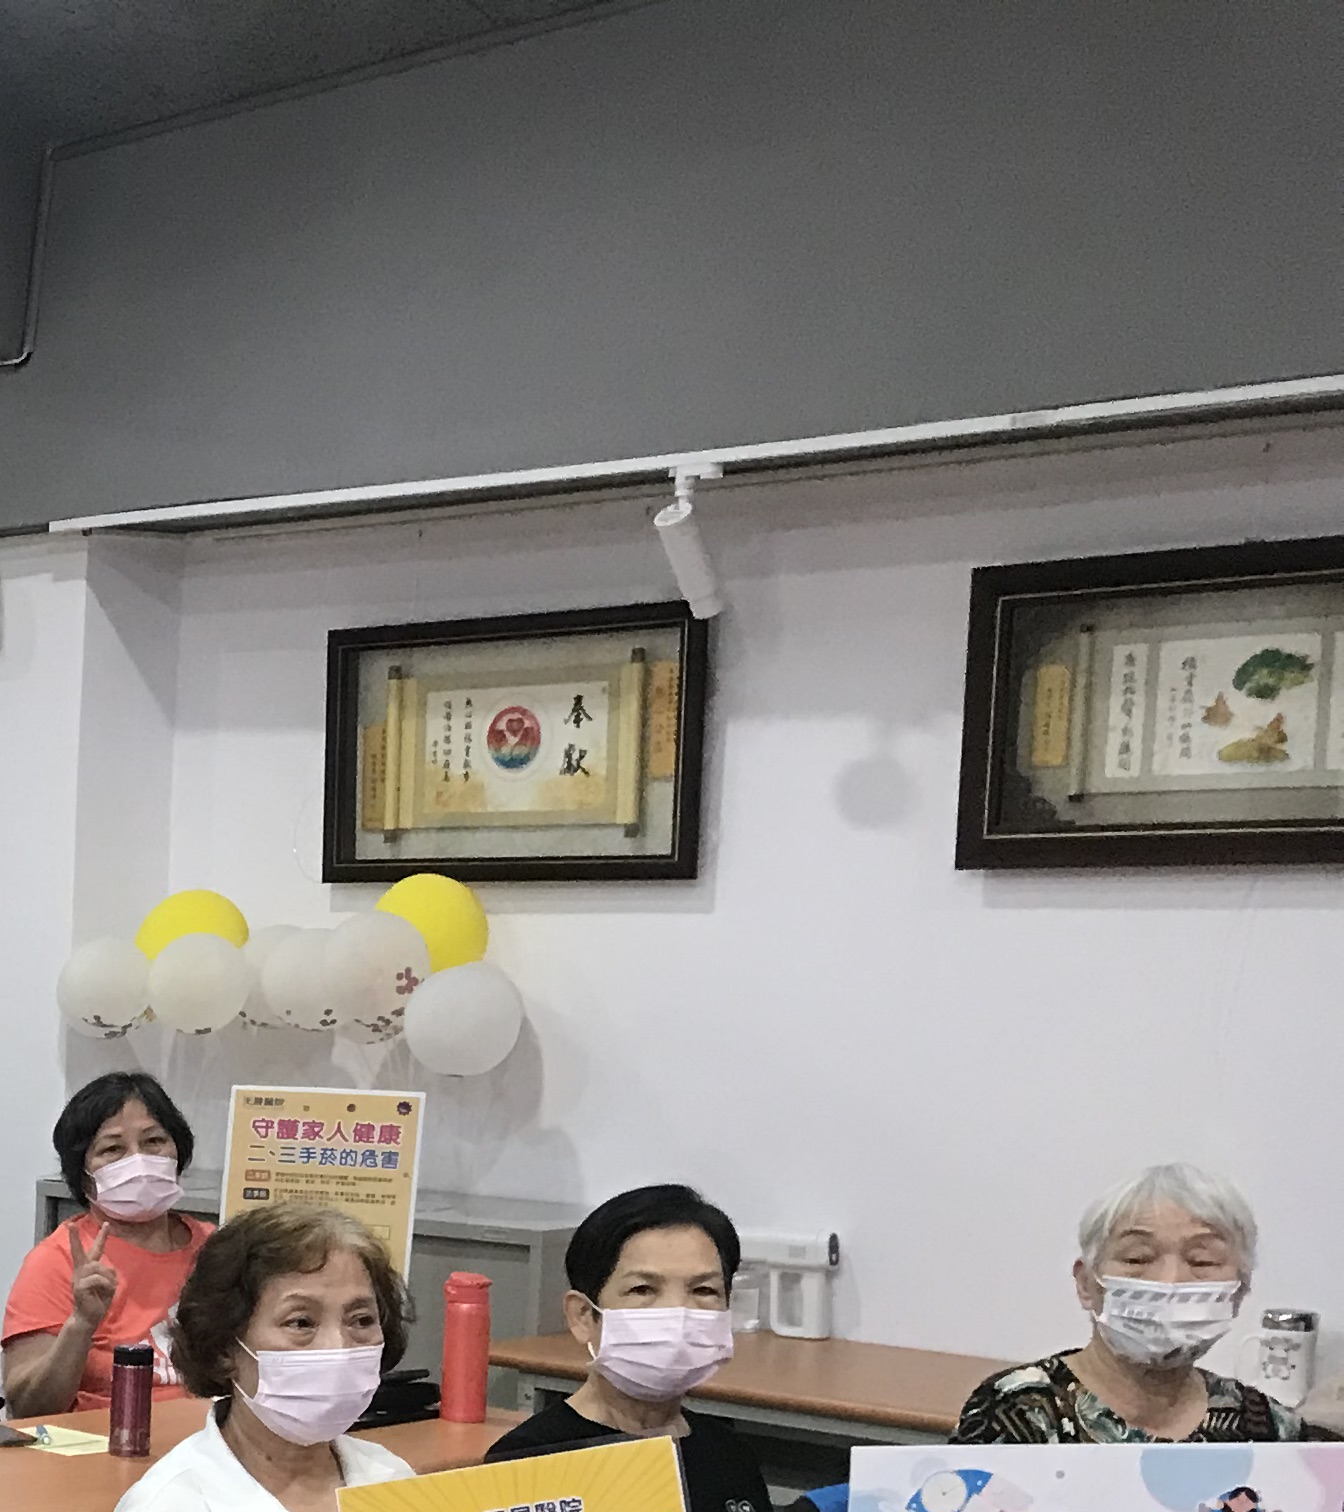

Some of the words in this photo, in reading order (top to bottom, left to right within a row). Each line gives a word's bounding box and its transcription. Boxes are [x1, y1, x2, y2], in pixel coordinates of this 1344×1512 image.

[252, 1118, 402, 1145] 守護家人健康
[248, 1144, 400, 1169] 二、三手菸的危害
